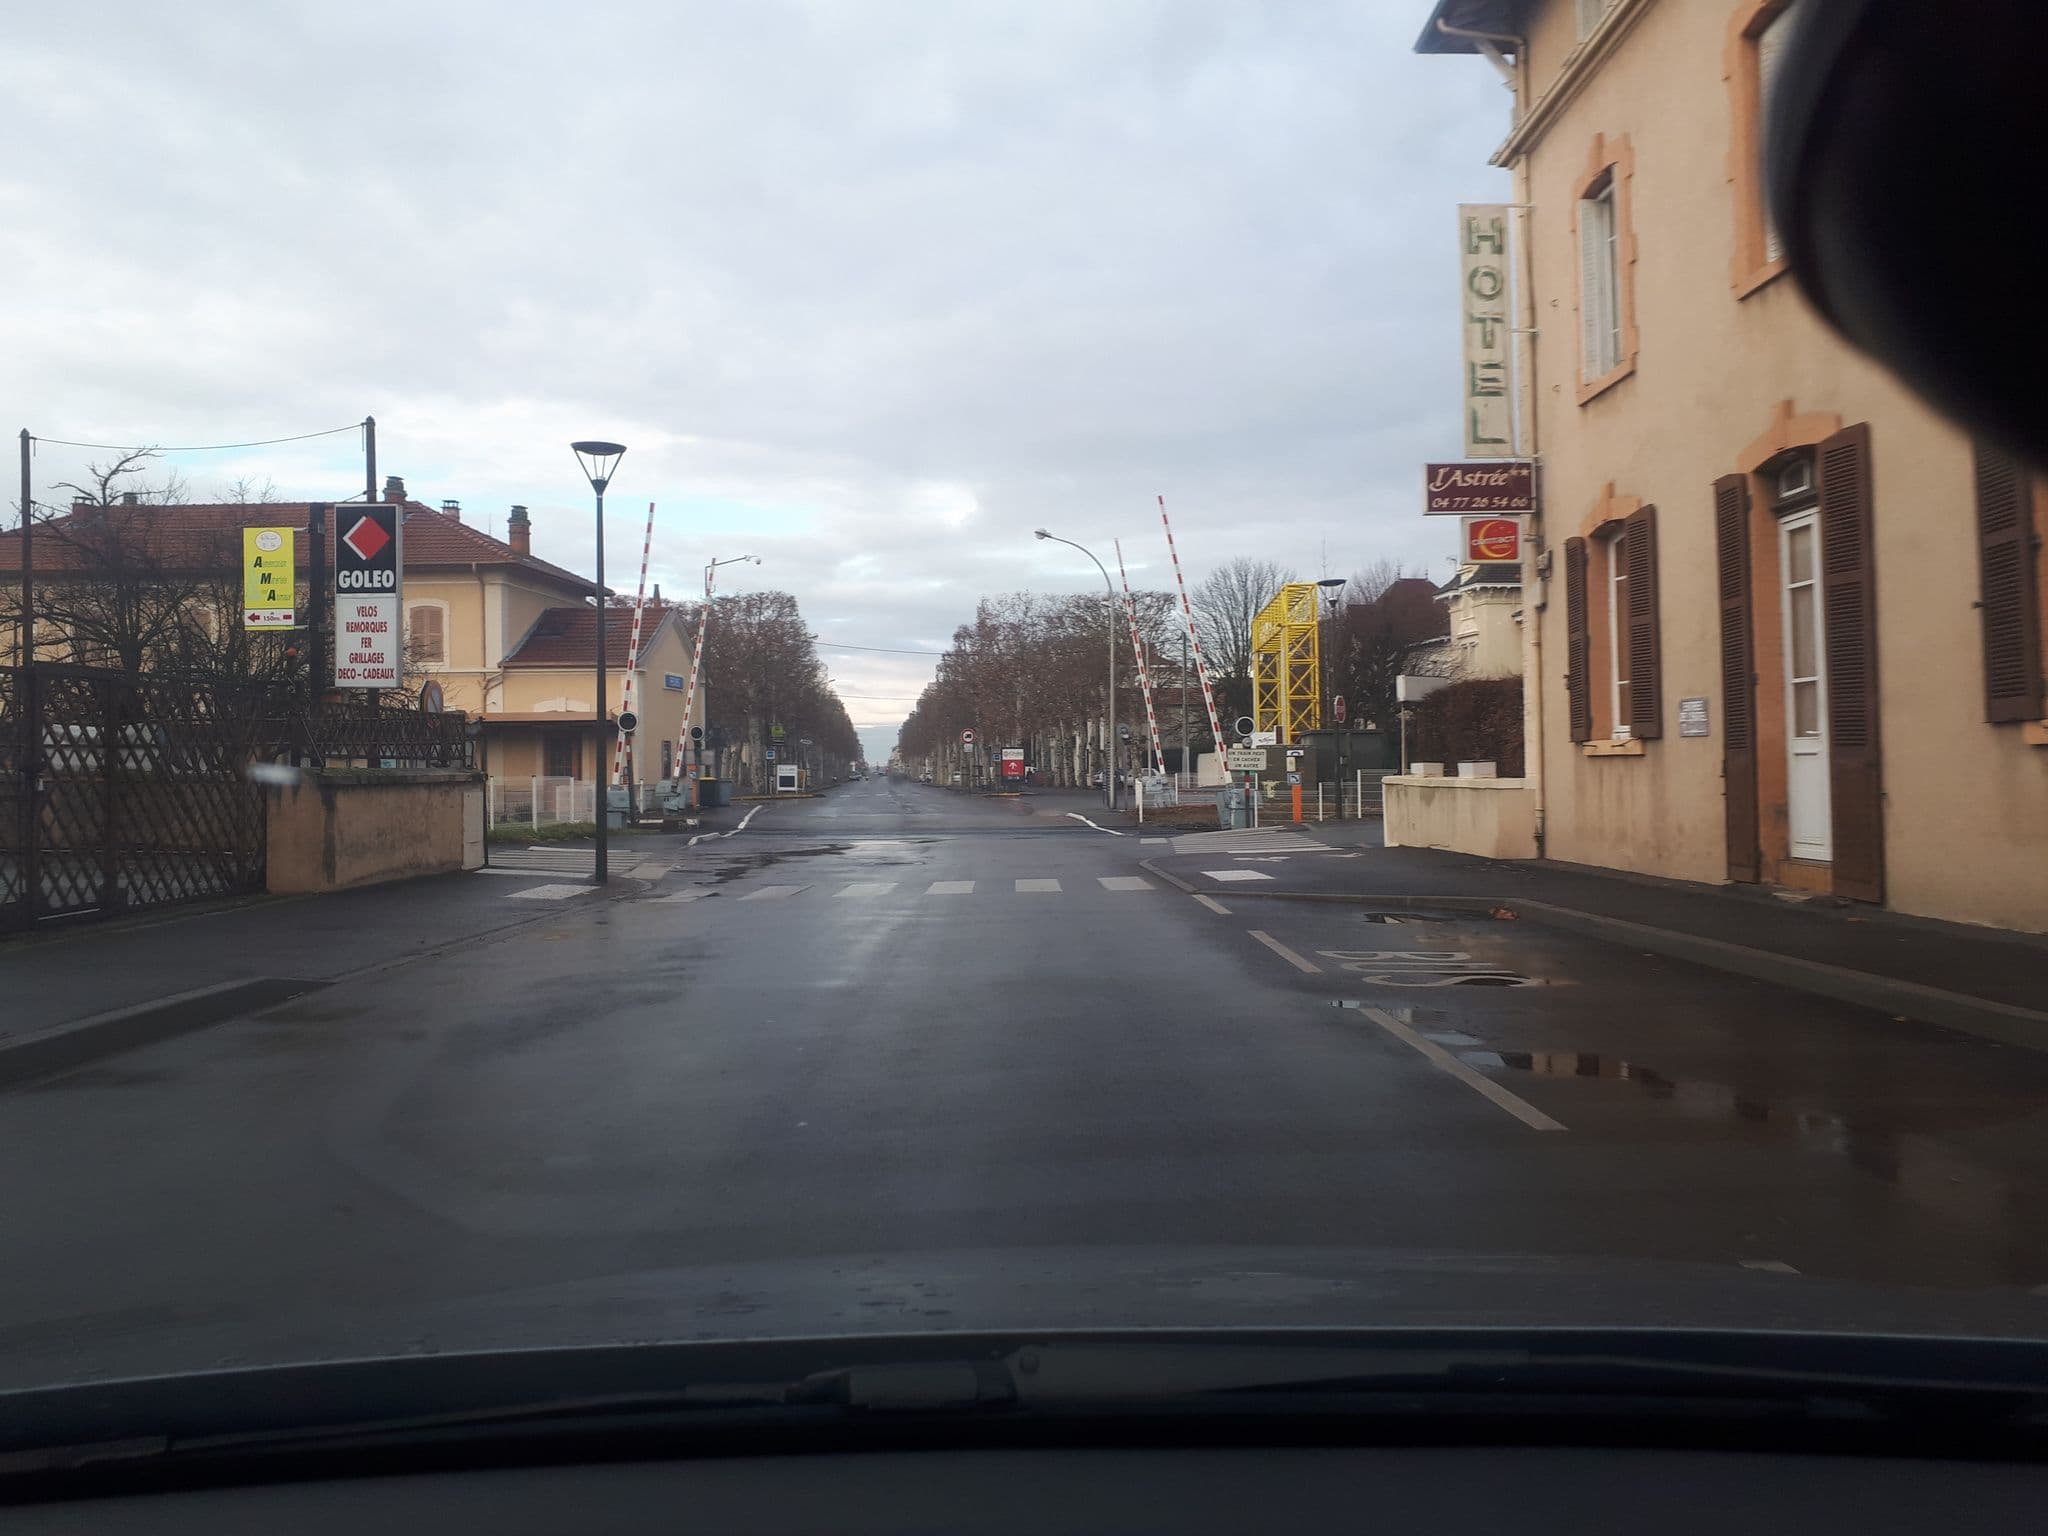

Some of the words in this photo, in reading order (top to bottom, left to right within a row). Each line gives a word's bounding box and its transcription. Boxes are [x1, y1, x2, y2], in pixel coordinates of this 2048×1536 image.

[1466, 216, 1507, 444] HOTEL
[1431, 496, 1449, 508] 04
[1452, 496, 1470, 508] 77
[338, 569, 395, 588] GOLEO
[356, 606, 378, 617] VELOS
[346, 621, 388, 634] REMORQUES
[360, 637, 372, 648] FER
[349, 652, 385, 664] GRILLAGES
[338, 668, 356, 680] DECO
[362, 668, 395, 680] CADEAUX
